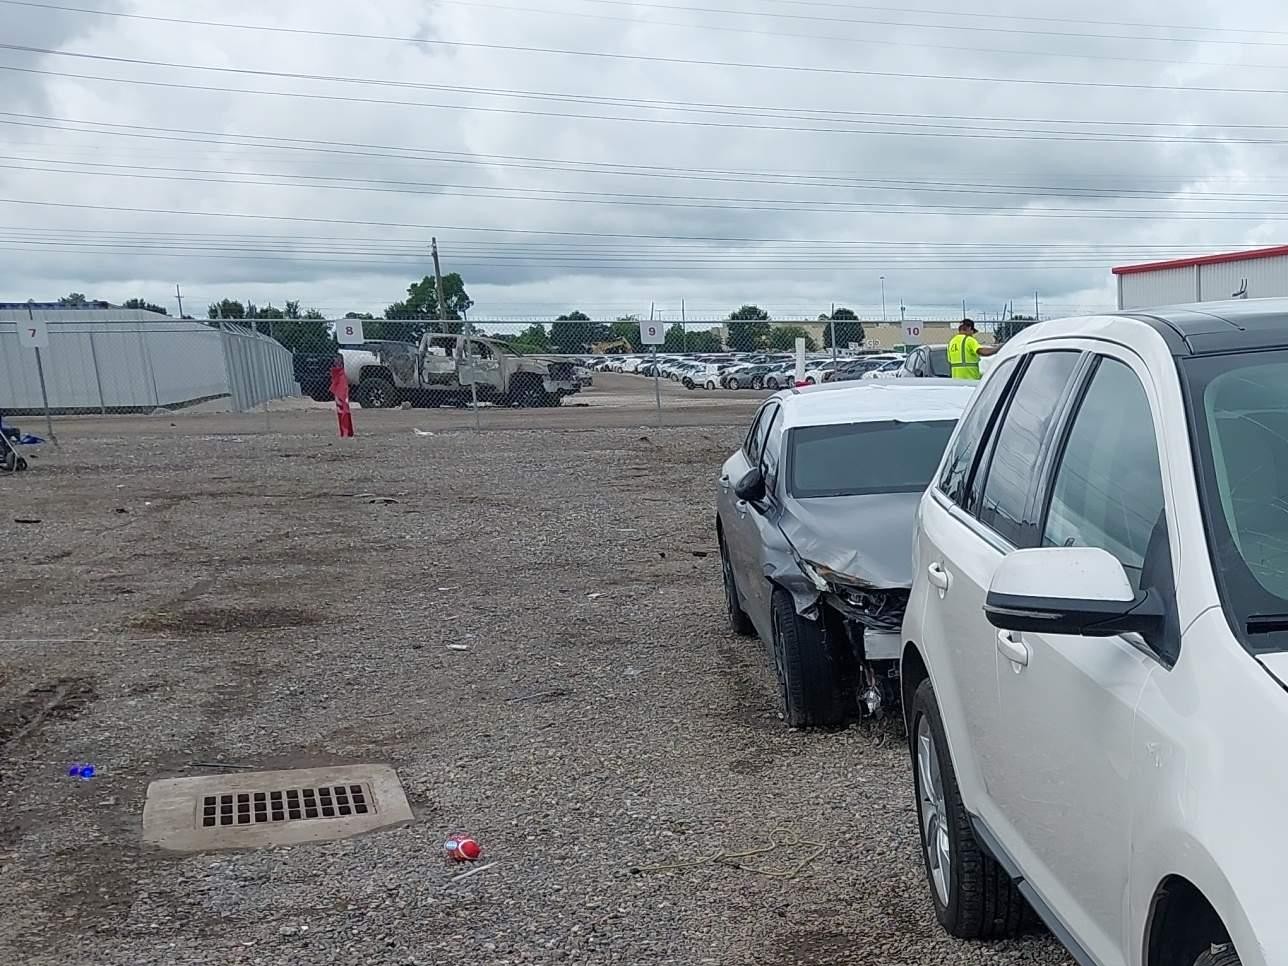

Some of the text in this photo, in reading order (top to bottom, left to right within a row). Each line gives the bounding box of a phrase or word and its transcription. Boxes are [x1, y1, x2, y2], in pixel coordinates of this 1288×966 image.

[27, 328, 36, 338] 7
[345, 326, 354, 336] 8
[648, 327, 656, 336] 9
[906, 327, 920, 336] 10
